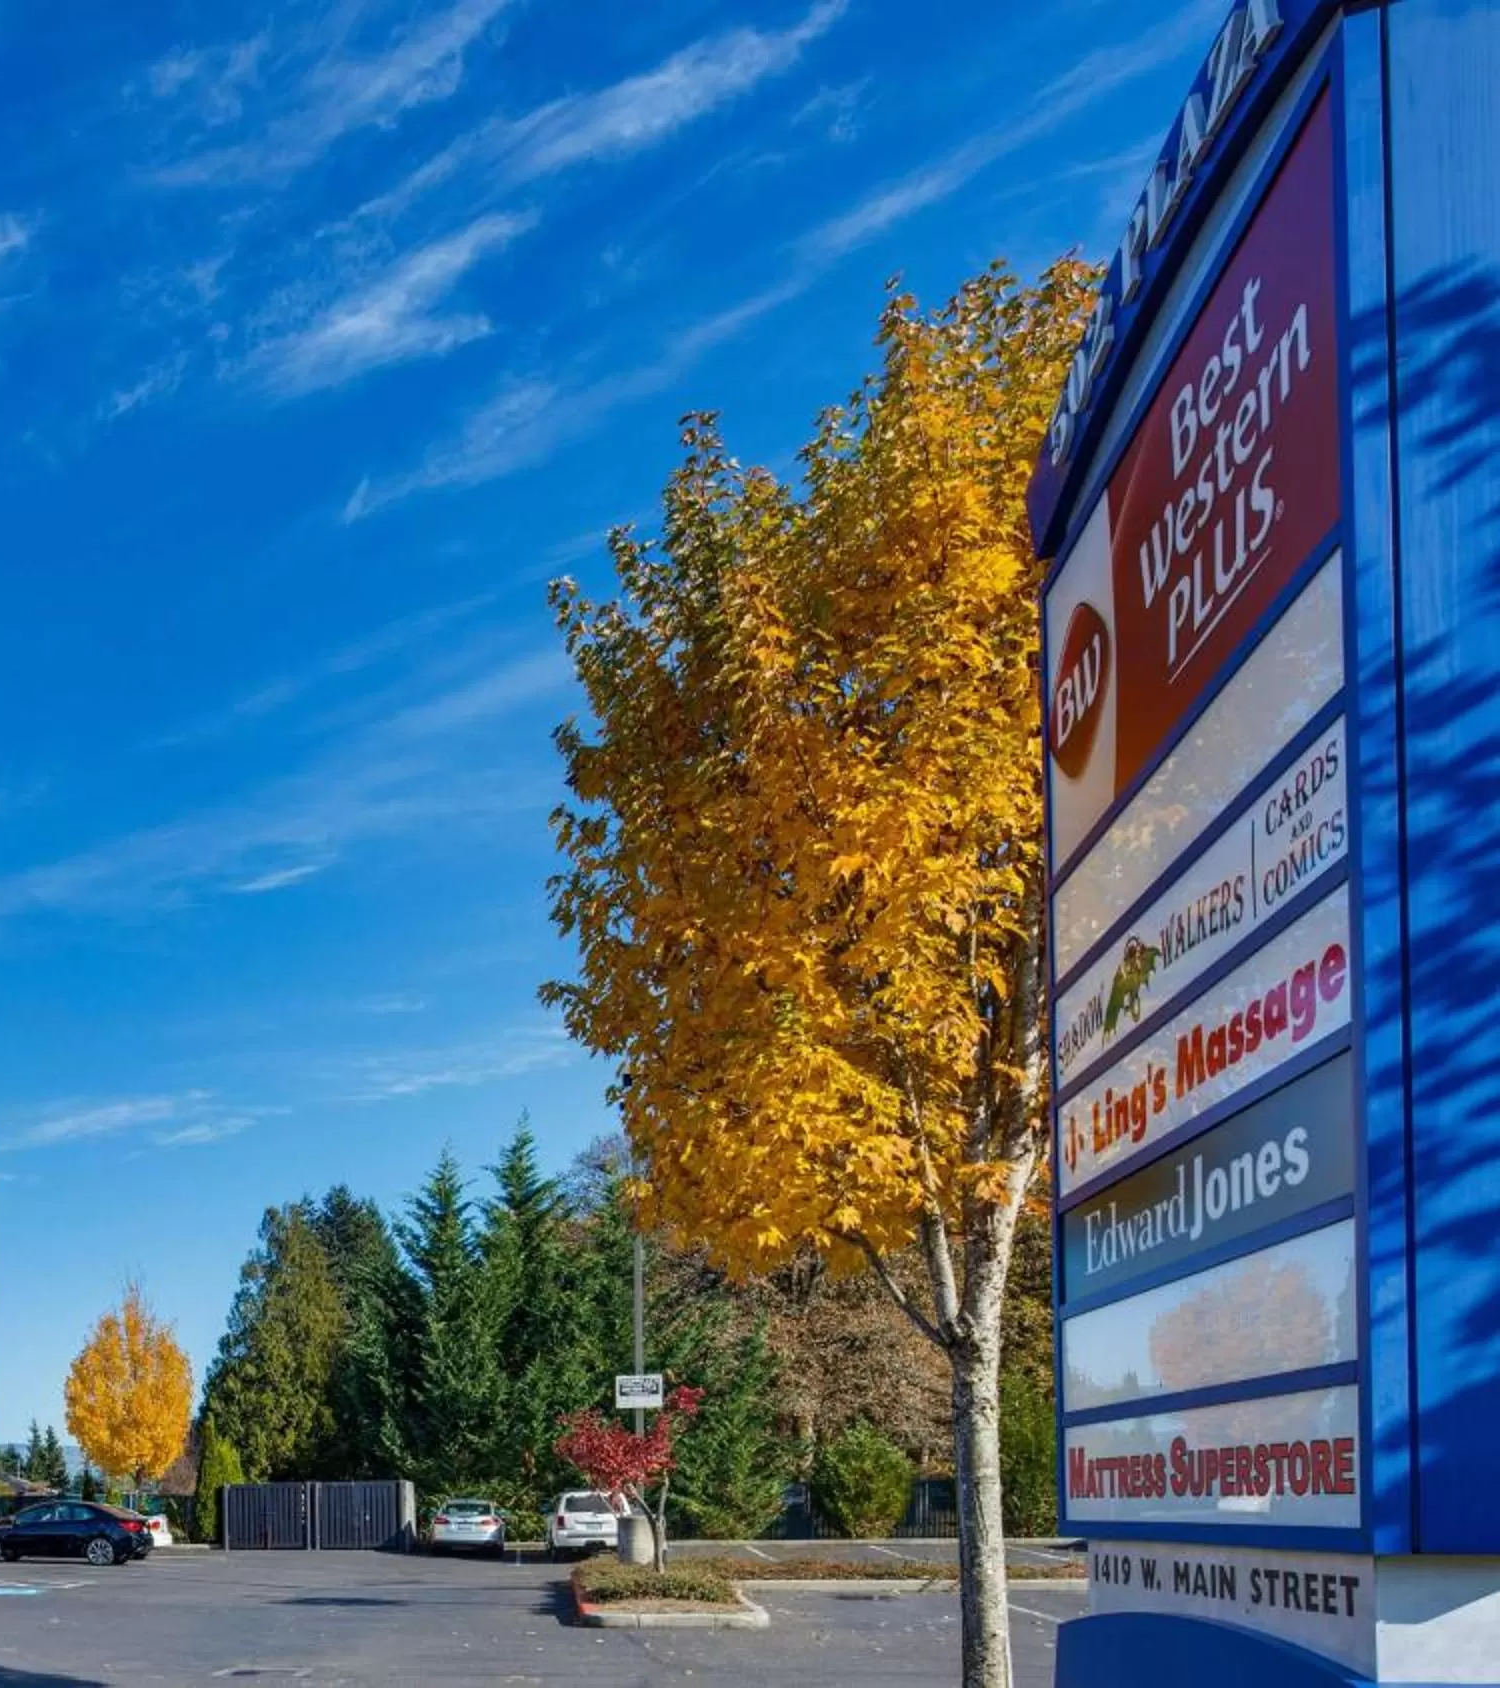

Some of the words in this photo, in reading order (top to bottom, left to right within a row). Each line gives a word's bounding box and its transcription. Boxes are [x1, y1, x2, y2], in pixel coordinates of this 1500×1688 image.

[1119, 0, 1284, 308] PLAZA
[1169, 276, 1264, 480] Best
[1139, 303, 1312, 608] Western
[1167, 445, 1275, 665] PLUS
[1057, 632, 1101, 749] BW
[1265, 739, 1339, 836] CARDS
[1290, 810, 1313, 844] AND
[1263, 808, 1345, 906] COMICS
[1159, 875, 1245, 970] WALKERS
[1091, 1062, 1167, 1153] Ling's
[1175, 943, 1347, 1099] Massage
[1068, 1446, 1167, 1498] MATTRESS
[1169, 1436, 1356, 1497] SUPERSTORE
[1094, 1553, 1131, 1585] 1419
[1140, 1557, 1162, 1590] W.
[1173, 1560, 1237, 1601] MAIN
[1250, 1568, 1360, 1617] STREET
